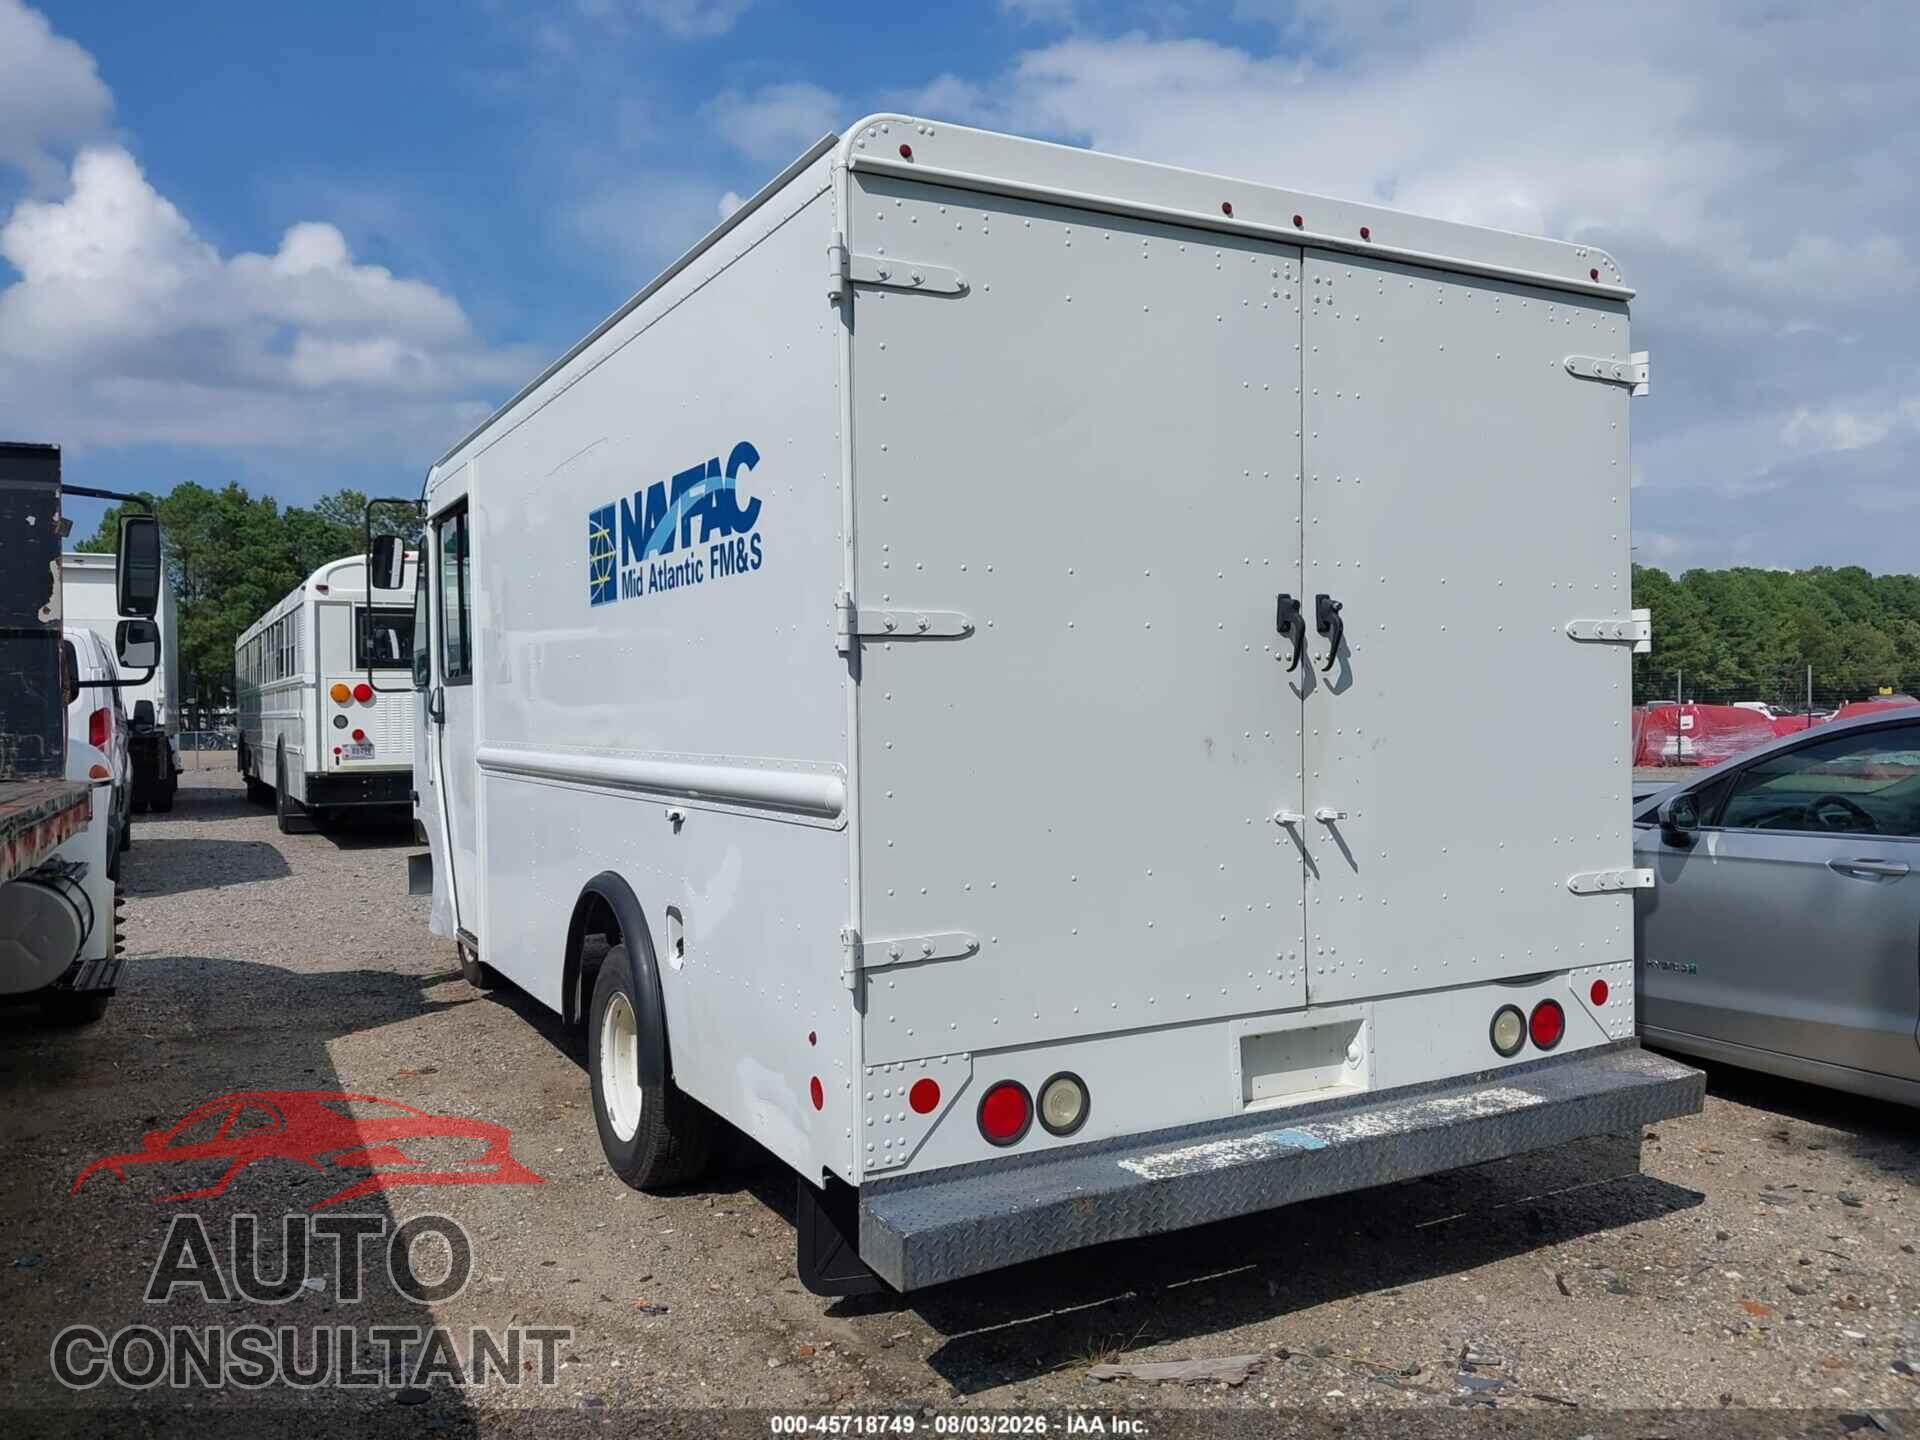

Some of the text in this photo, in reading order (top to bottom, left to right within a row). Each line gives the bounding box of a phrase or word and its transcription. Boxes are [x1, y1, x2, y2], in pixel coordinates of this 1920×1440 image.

[621, 532, 763, 600] Mid Atlantic FM&S
